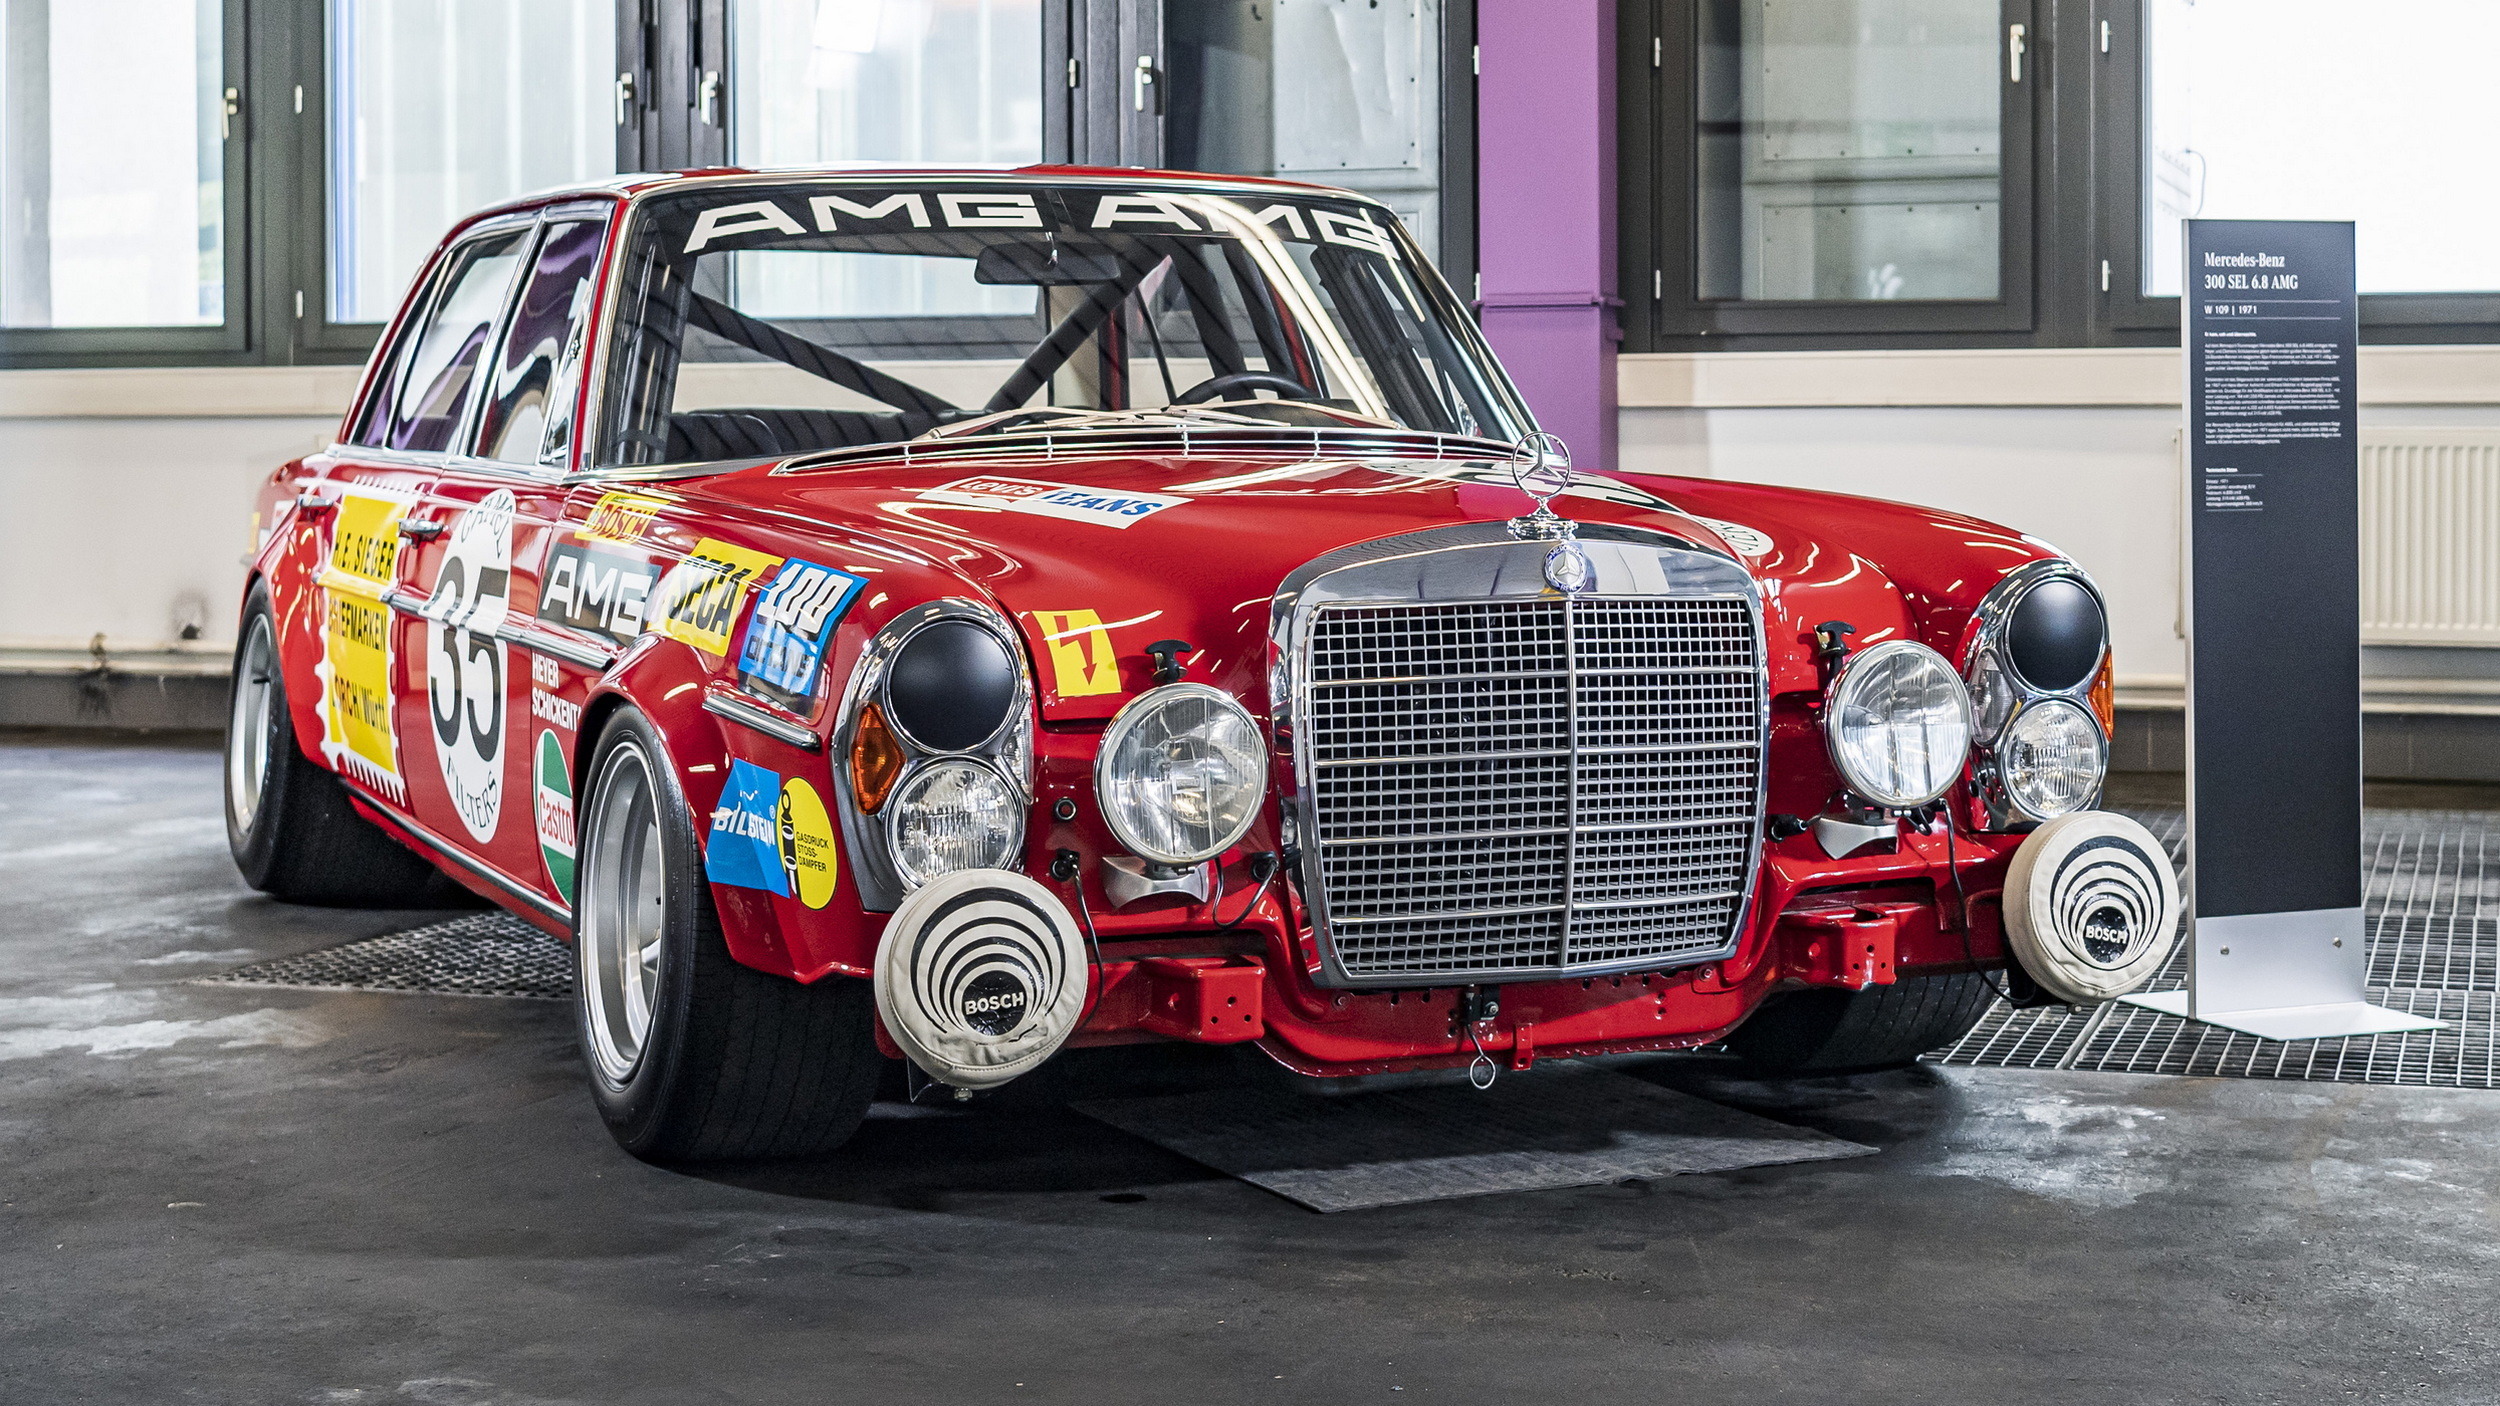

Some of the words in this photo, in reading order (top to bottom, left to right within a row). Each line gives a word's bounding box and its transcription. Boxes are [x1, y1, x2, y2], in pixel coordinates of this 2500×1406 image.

[684, 194, 1043, 253] AMG
[1091, 195, 1400, 261] AMG
[2204, 252, 2285, 267] Mercedes-Benz
[2204, 274, 2226, 289] 300
[2228, 274, 2249, 289] SEL
[2251, 275, 2268, 289] 6.8
[2271, 275, 2298, 289] AMG
[2204, 305, 2213, 315] W
[2215, 305, 2229, 315] 109
[2238, 305, 2257, 315] 1971
[588, 504, 653, 541] BOSCH
[354, 534, 395, 581] SIEGER
[541, 554, 653, 638] AMG
[756, 563, 854, 635] 100
[328, 597, 388, 652] BRIEFMARKEN
[424, 556, 509, 762] 35
[532, 652, 559, 689] HEYER
[539, 791, 574, 847] Castro
[713, 801, 776, 845] BILSTEIN
[796, 831, 829, 849] GASDRUCK
[796, 844, 818, 858] STOSS-
[2085, 925, 2128, 944] BOSCH
[964, 991, 1025, 1016] BOSCH
